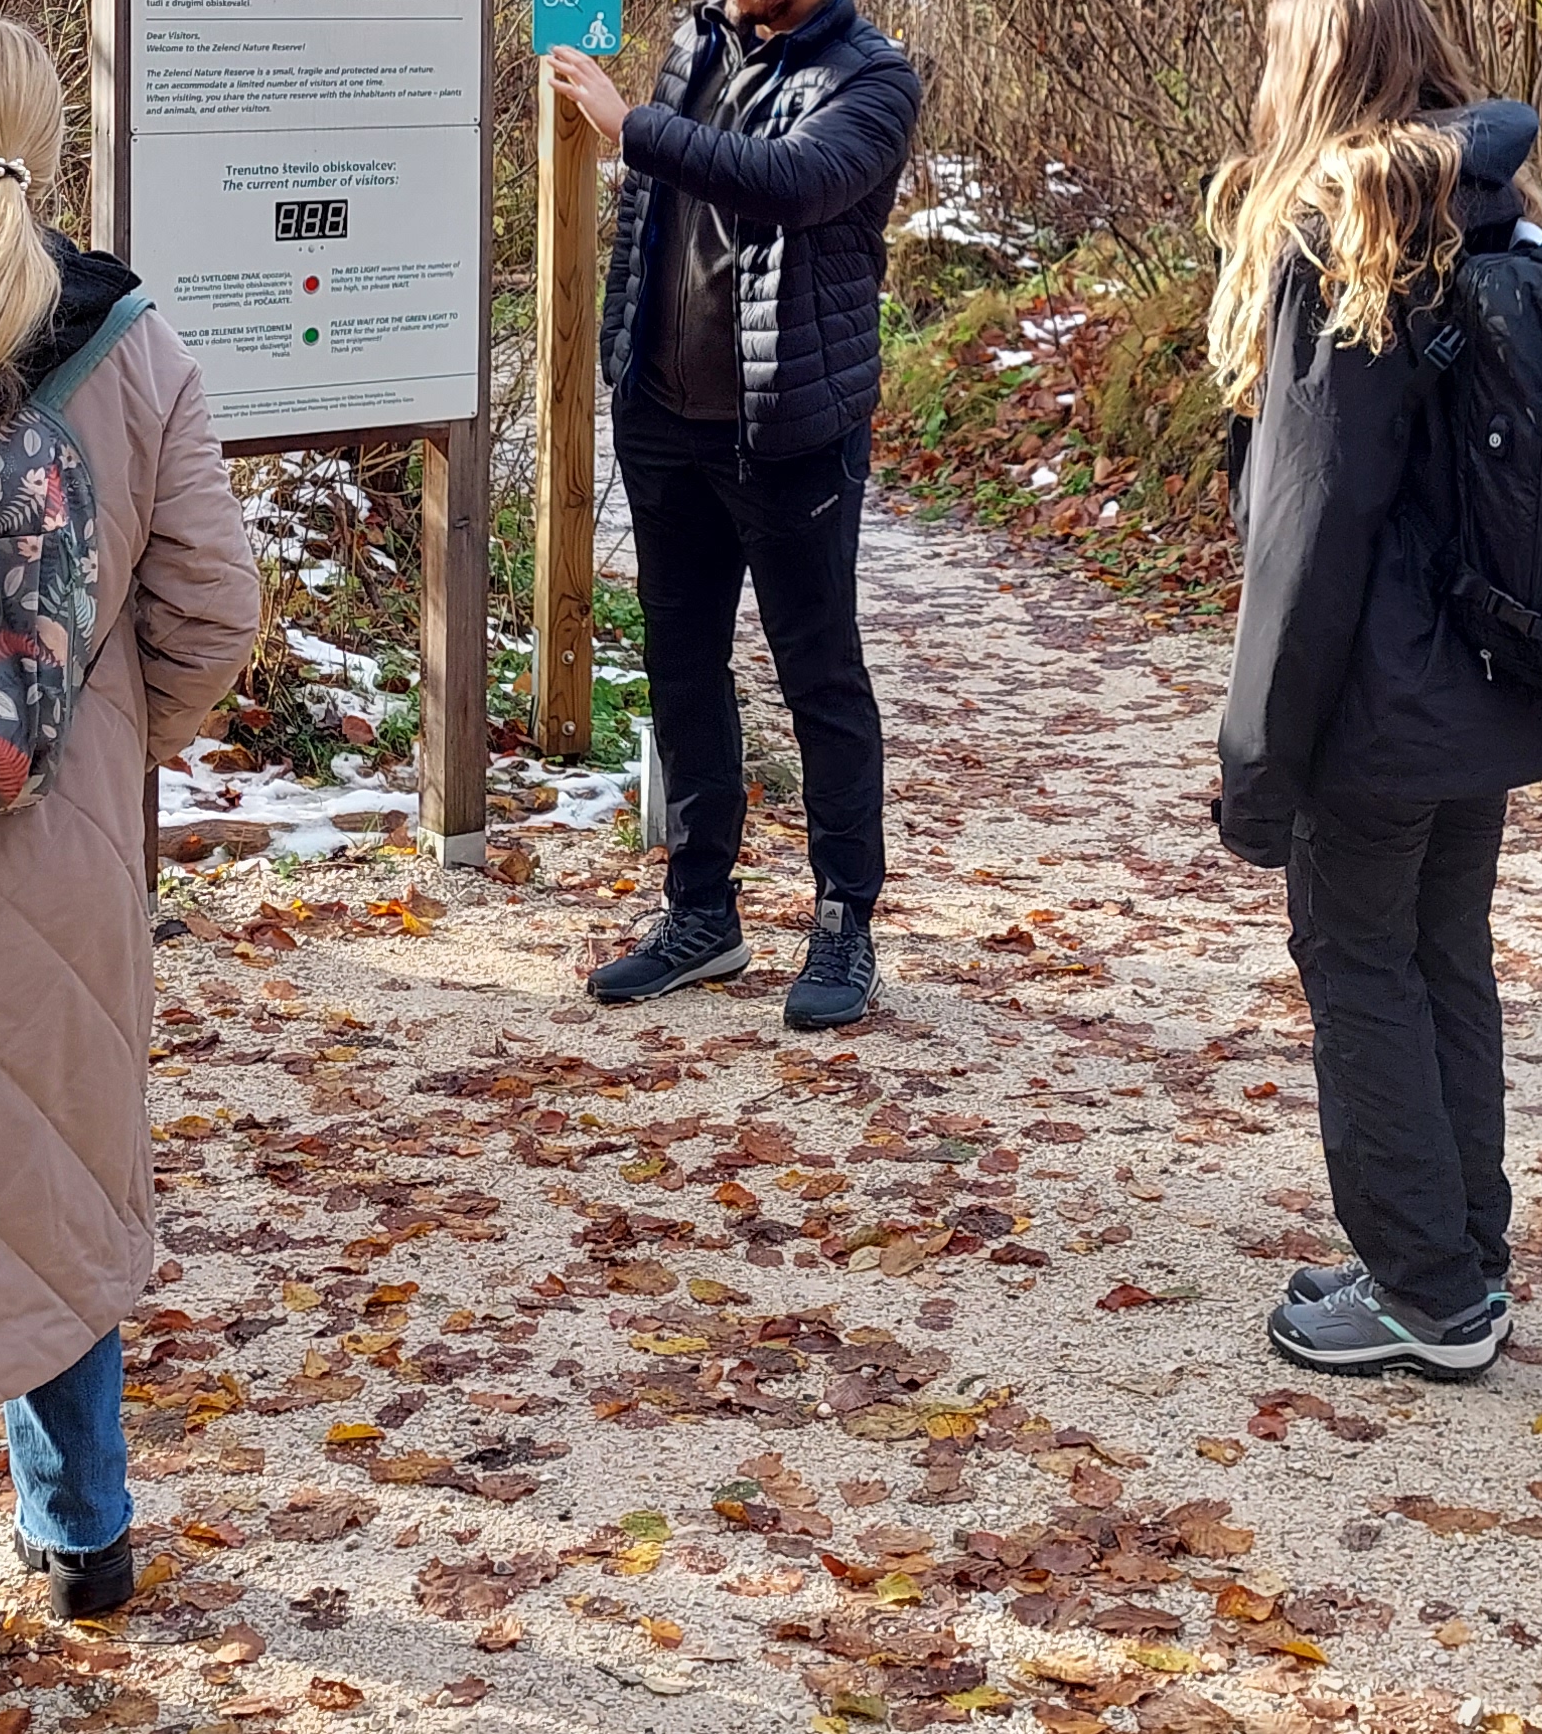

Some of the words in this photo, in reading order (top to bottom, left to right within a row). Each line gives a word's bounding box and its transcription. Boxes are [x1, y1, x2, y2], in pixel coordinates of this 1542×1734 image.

[282, 162, 319, 174] število
[322, 160, 396, 172] obiskovalcev:
[223, 179, 243, 191] The
[292, 176, 337, 188] number
[340, 174, 352, 186] of
[355, 174, 399, 185] visitors:
